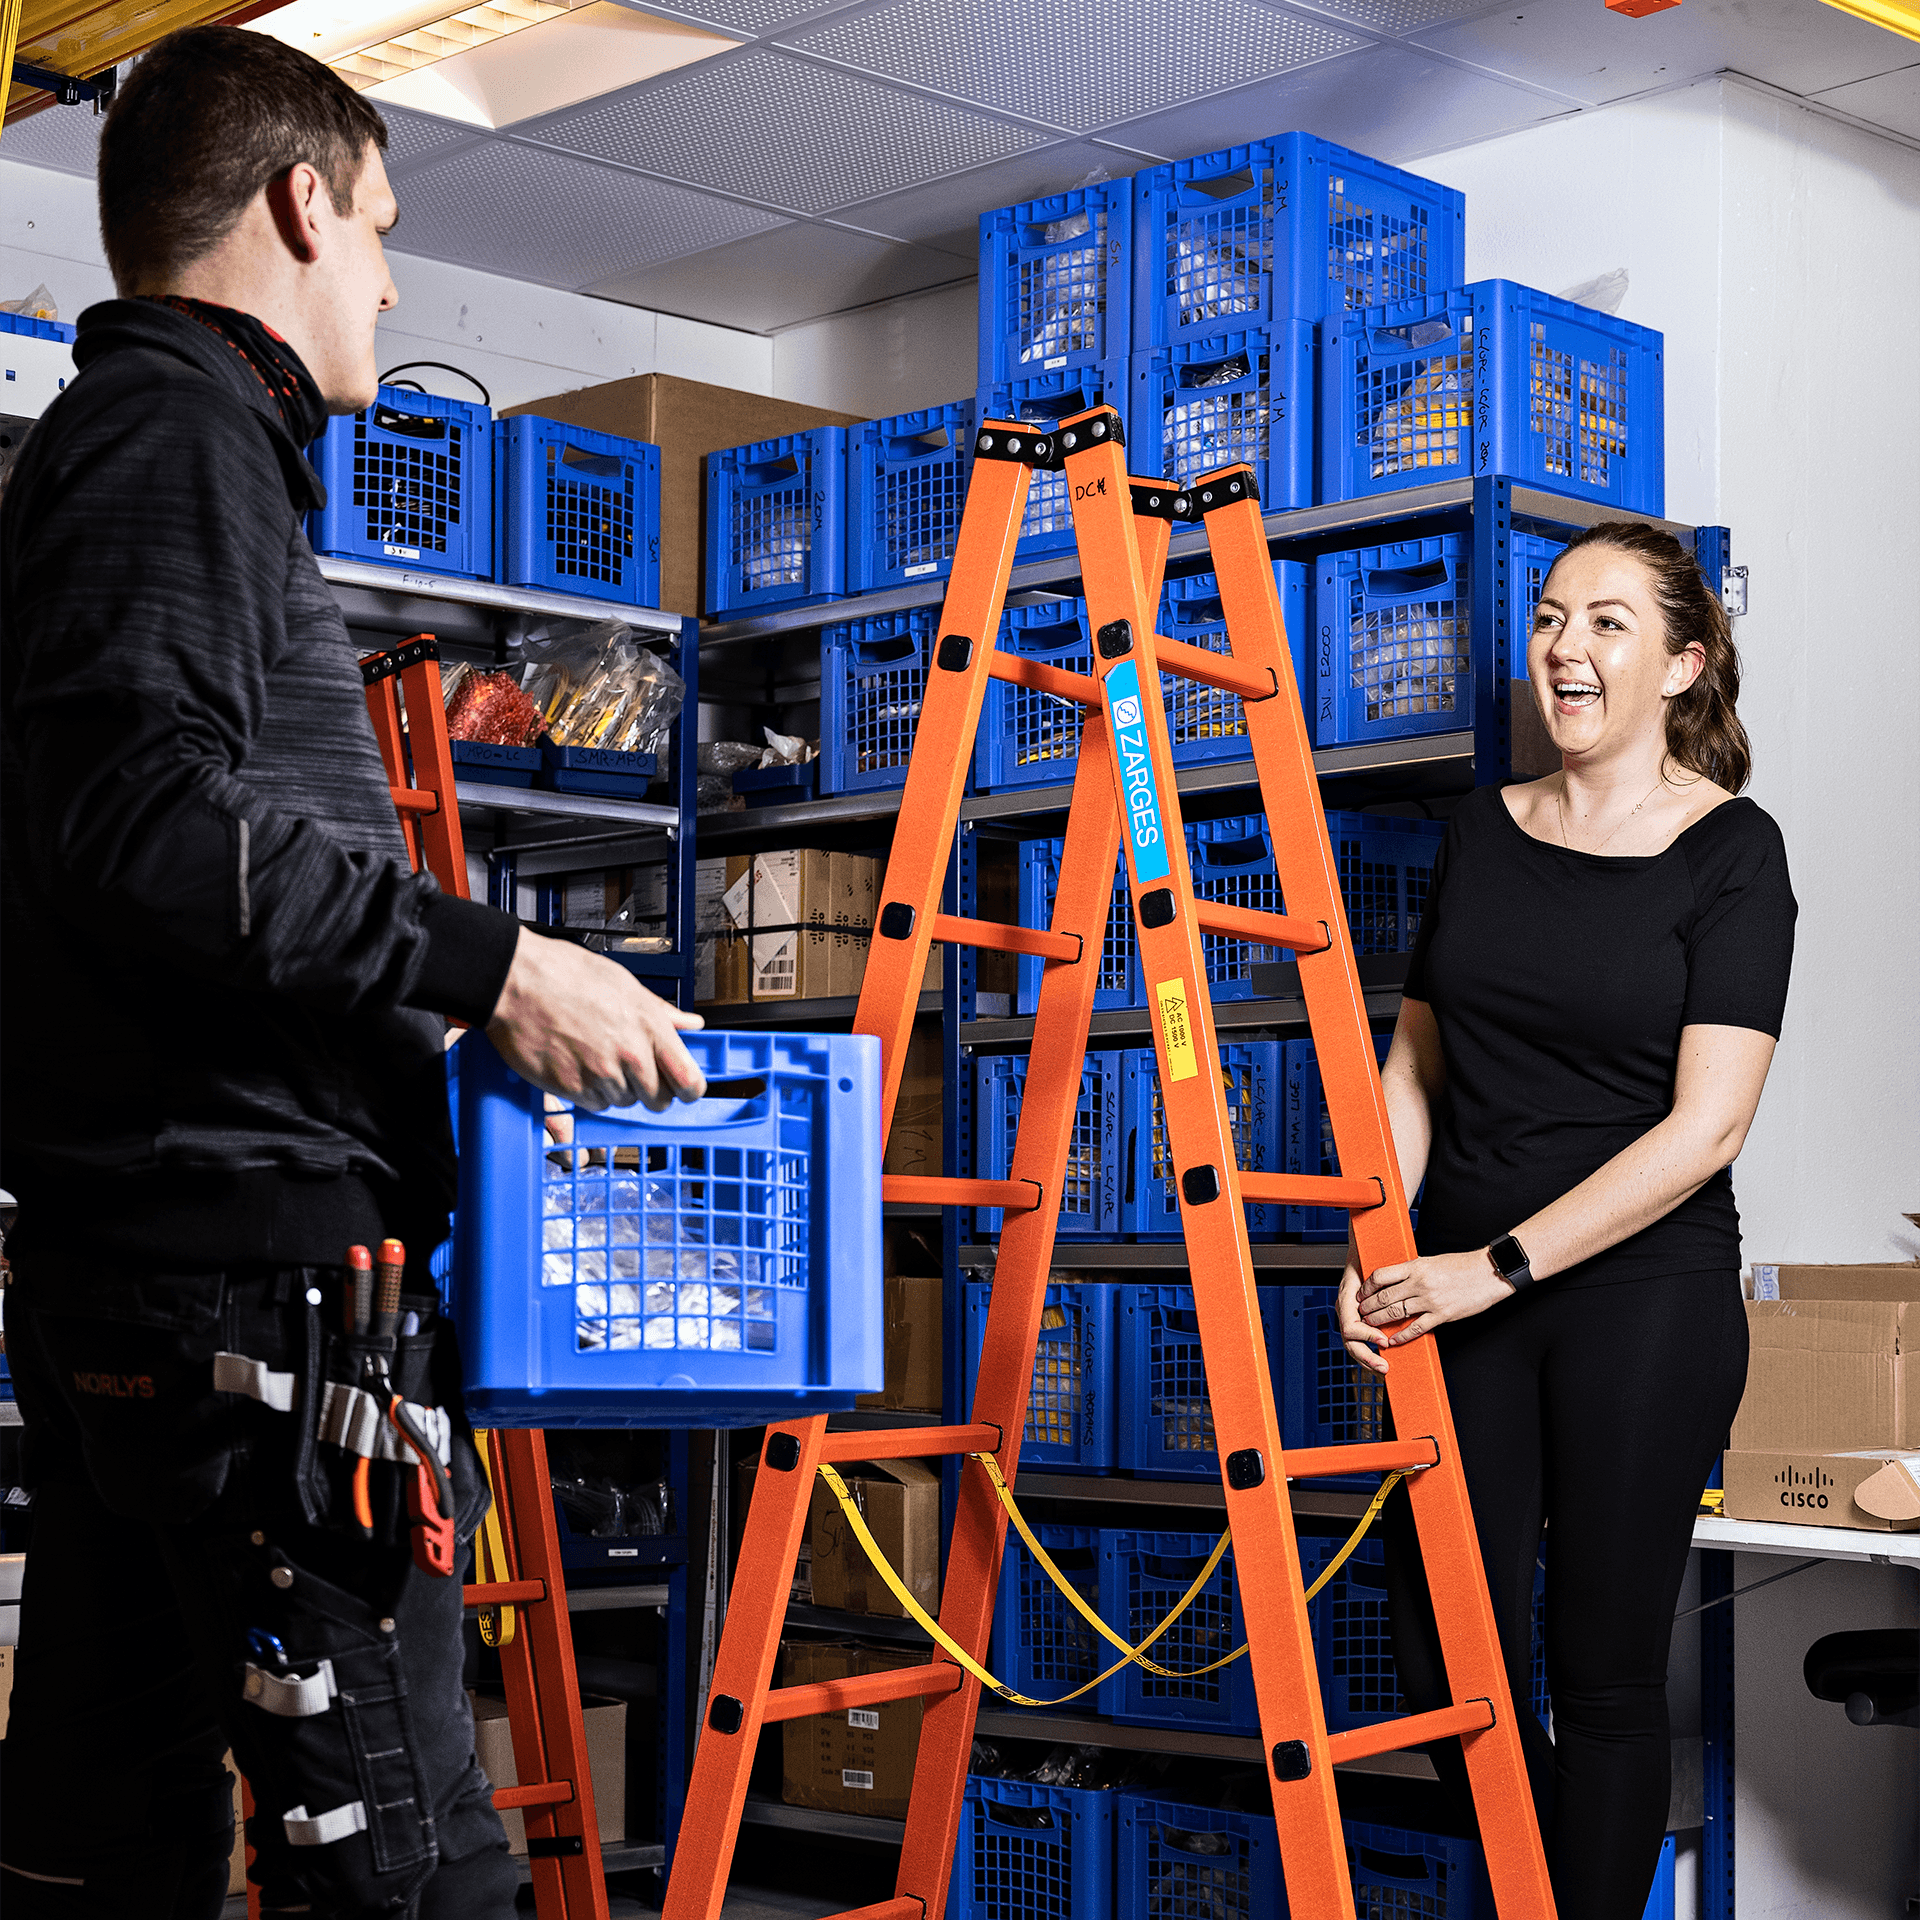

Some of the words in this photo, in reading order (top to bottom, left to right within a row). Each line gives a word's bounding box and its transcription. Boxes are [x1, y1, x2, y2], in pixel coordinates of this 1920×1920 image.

[1275, 180, 1288, 214] 3M
[1272, 392, 1287, 424] 1M
[1320, 625, 1331, 678] E2000
[1119, 729, 1159, 848] ZARGES
[1169, 1013, 1176, 1025] DC
[1176, 1012, 1184, 1023] AC
[1178, 1024, 1186, 1040] 1000
[1171, 1026, 1179, 1042] 1500
[72, 1370, 156, 1399] NORLYS
[1780, 1491, 1829, 1509] CISCO
[480, 1611, 495, 1646] GES
